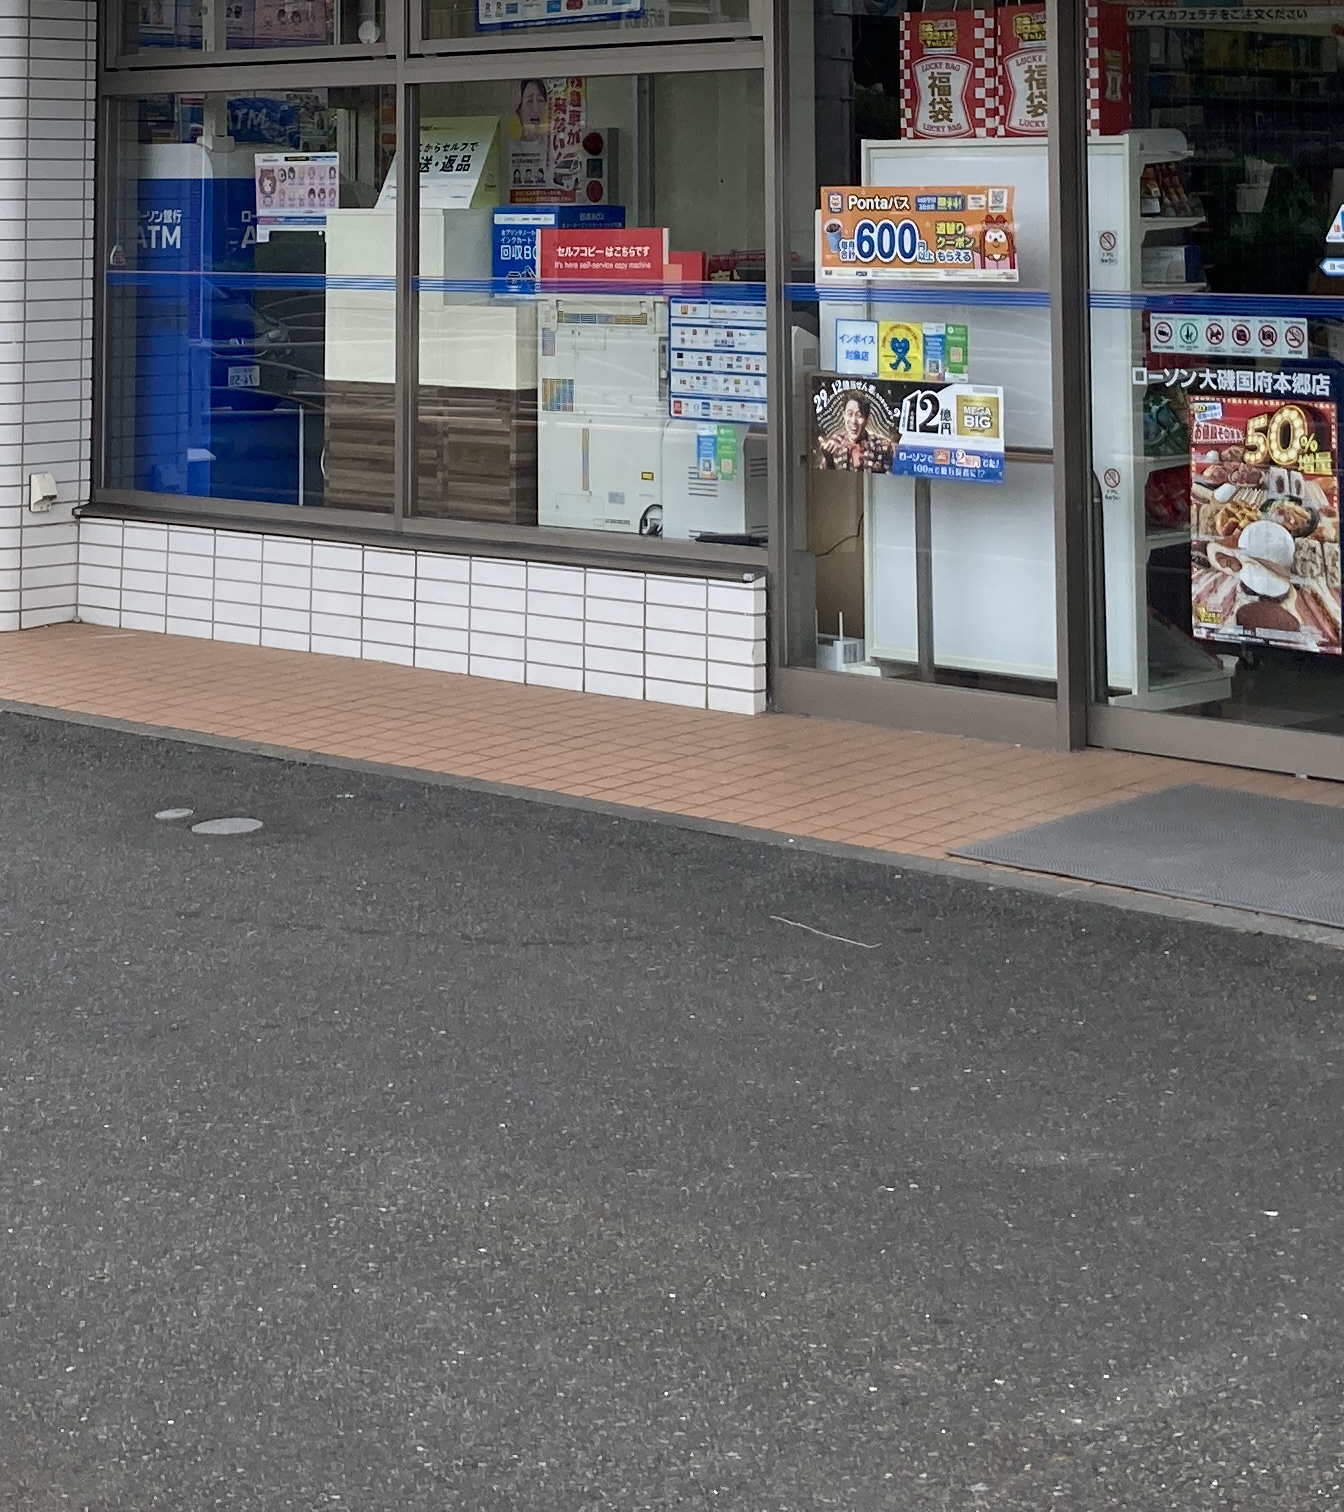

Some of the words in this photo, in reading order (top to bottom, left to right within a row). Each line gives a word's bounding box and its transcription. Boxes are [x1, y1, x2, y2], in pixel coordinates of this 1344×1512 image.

[1015, 54, 1043, 67] LUCKY
[928, 71, 954, 123] 福袋
[847, 194, 911, 211] Pontaパス
[856, 221, 917, 261] 600
[838, 334, 876, 345] インボイス
[1132, 366, 1331, 396] ローソン大磯国府本郷店
[963, 405, 993, 416] MEGA
[963, 415, 993, 429] BIG
